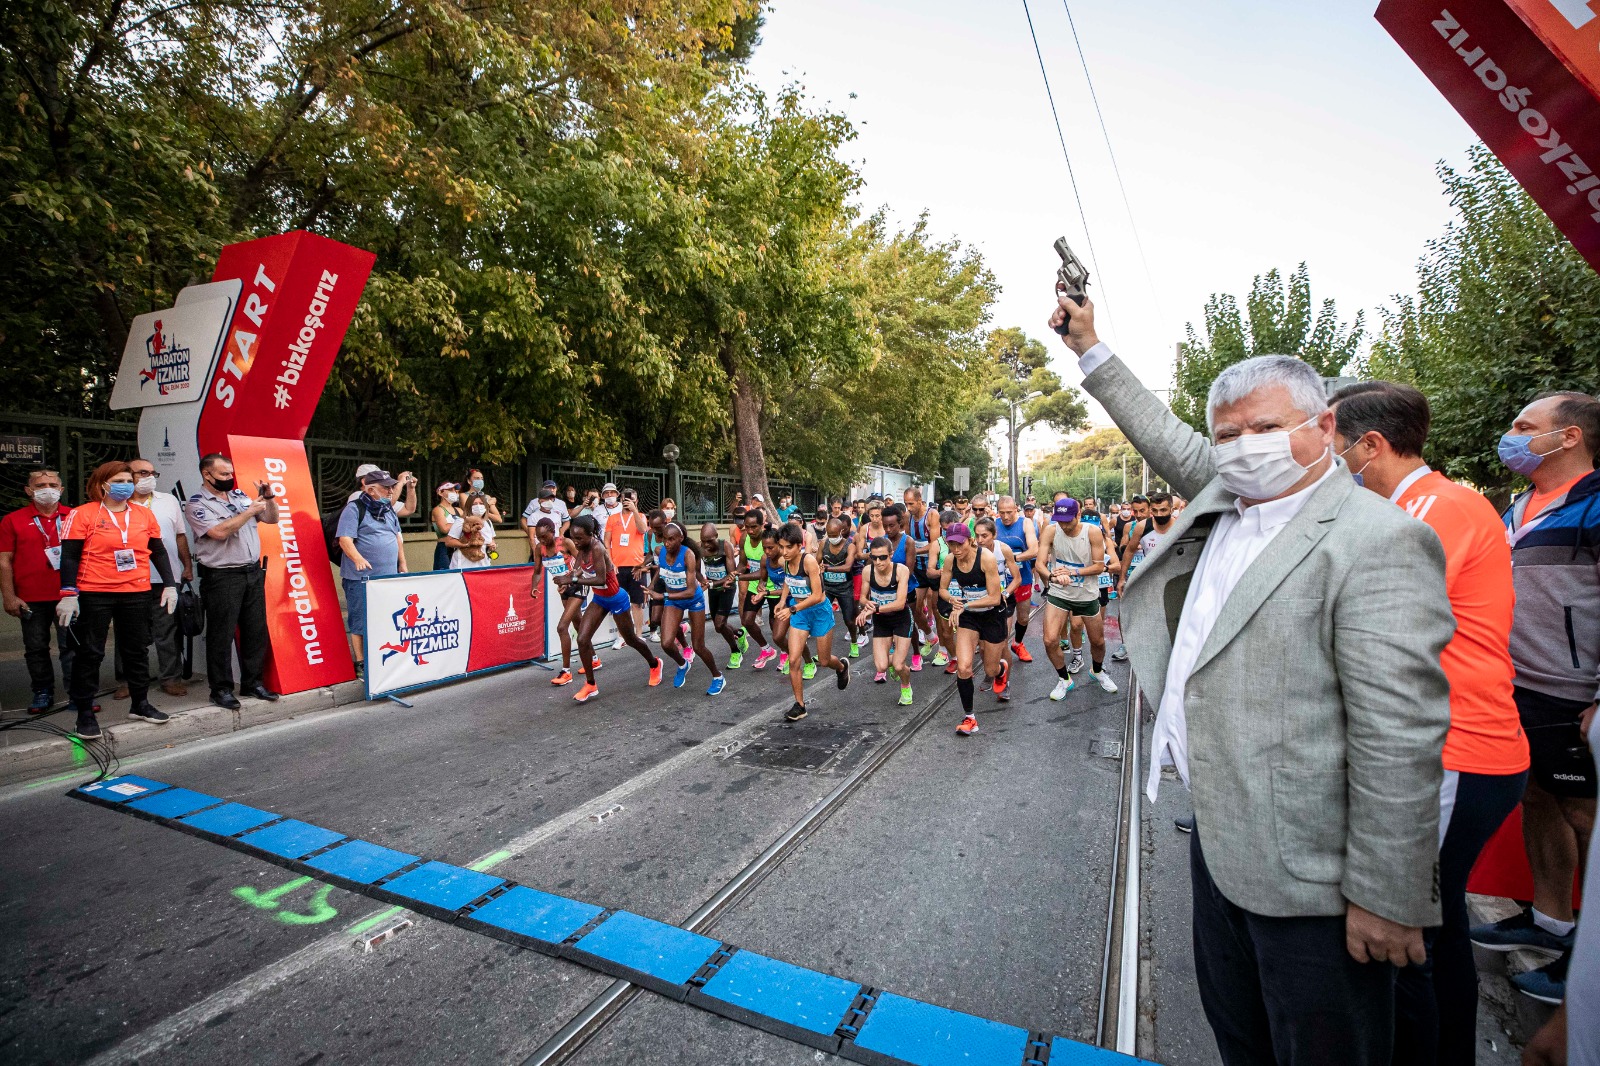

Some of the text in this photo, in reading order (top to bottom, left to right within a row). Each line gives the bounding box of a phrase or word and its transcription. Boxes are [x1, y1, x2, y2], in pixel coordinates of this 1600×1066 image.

[215, 263, 276, 409] START
[273, 269, 339, 410] #bizkoşarız
[151, 350, 190, 368] MARATON
[401, 620, 458, 641] MARATON
[1553, 773, 1586, 782] adidas
